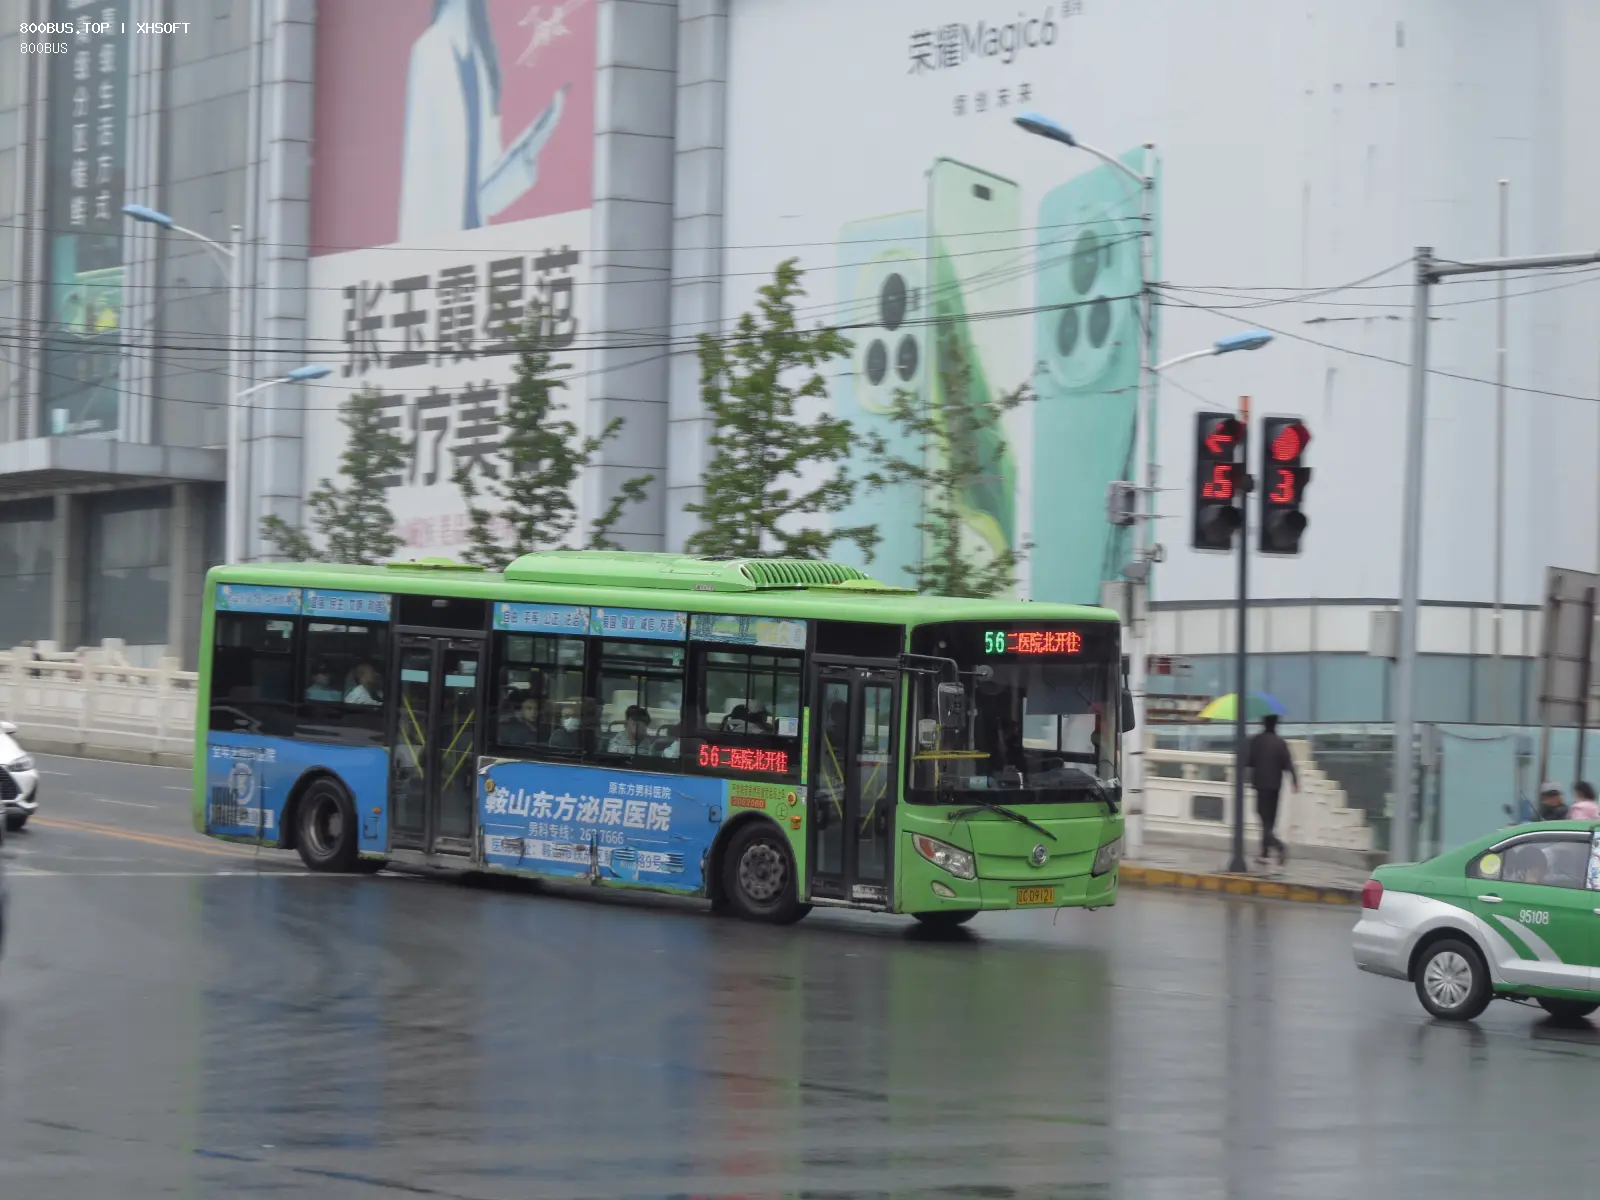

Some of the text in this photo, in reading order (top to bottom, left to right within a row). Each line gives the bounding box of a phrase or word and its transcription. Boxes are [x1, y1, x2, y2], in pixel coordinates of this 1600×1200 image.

[354, 379, 550, 487] 疗美
[984, 631, 1005, 653] 56
[699, 744, 719, 767] 56
[608, 781, 672, 799] 原东方男科医院
[484, 787, 673, 831] 鞍山东方泌尿医院
[1519, 909, 1549, 925] 95108
